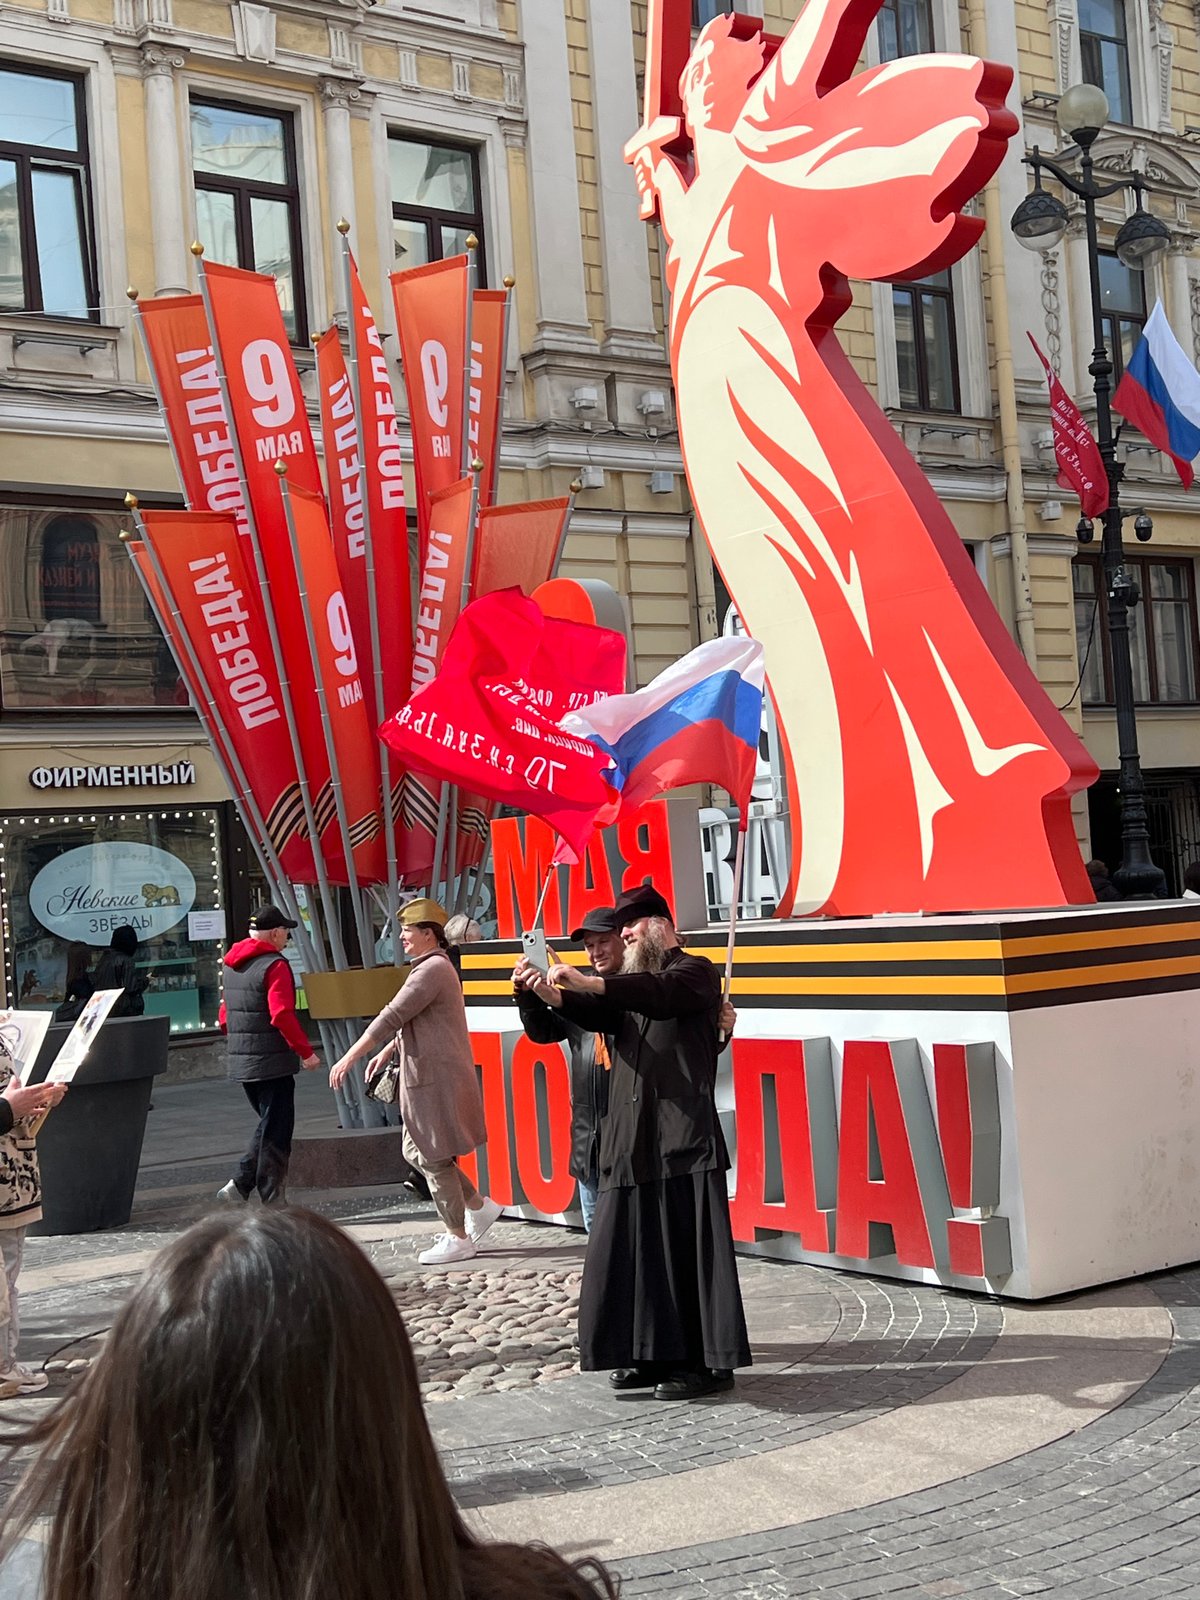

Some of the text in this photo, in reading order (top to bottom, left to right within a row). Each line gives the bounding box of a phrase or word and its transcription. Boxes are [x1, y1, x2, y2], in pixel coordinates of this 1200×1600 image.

[241, 339, 296, 429] 9
[255, 431, 304, 462] МАЯ
[188, 552, 281, 730] ПОБЕДА!
[326, 590, 358, 677] 9
[337, 679, 364, 709] МА
[30, 760, 196, 789] ФИРМЕННЫЙ
[46, 884, 139, 917] Невские
[89, 914, 153, 933] ЗВЁЗДЫ
[458, 1029, 987, 1277] ПОДА!
